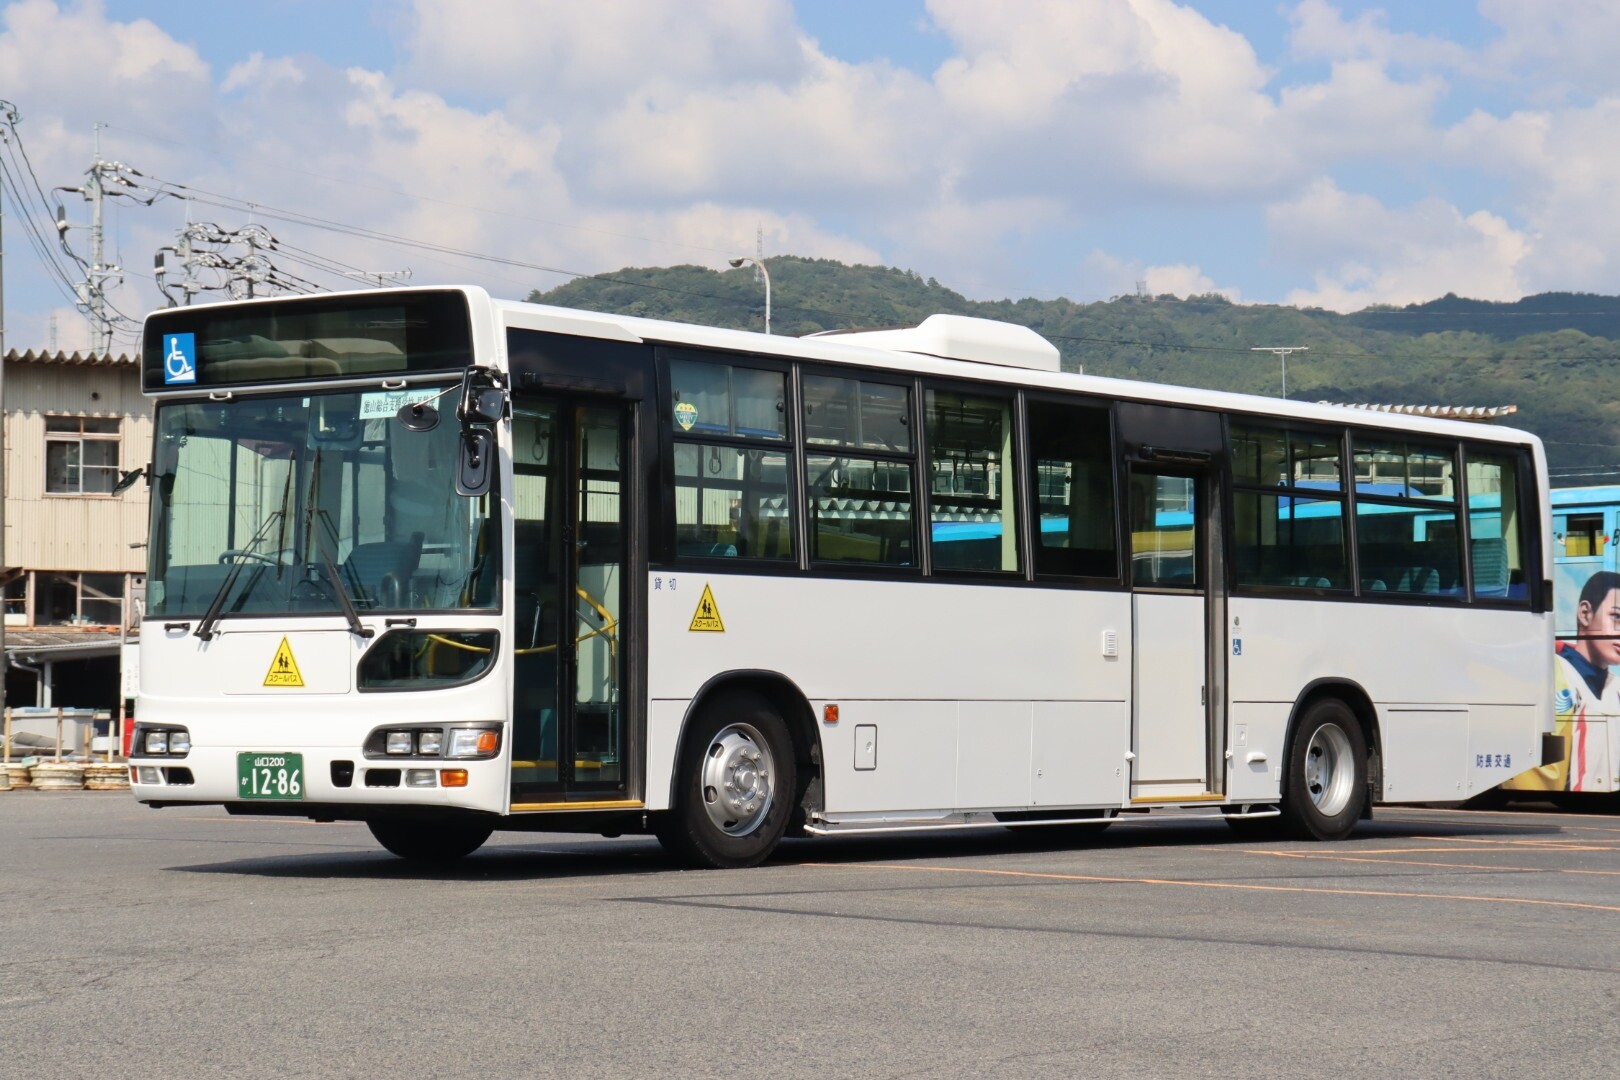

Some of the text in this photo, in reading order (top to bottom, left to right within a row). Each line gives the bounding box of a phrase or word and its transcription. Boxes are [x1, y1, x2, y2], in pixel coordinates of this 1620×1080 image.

[654, 576, 677, 591] 貸切
[693, 619, 719, 628] スクールバス
[269, 674, 298, 683] スクールバス
[1476, 753, 1511, 768] 防長交通
[252, 768, 300, 795] 12-86
